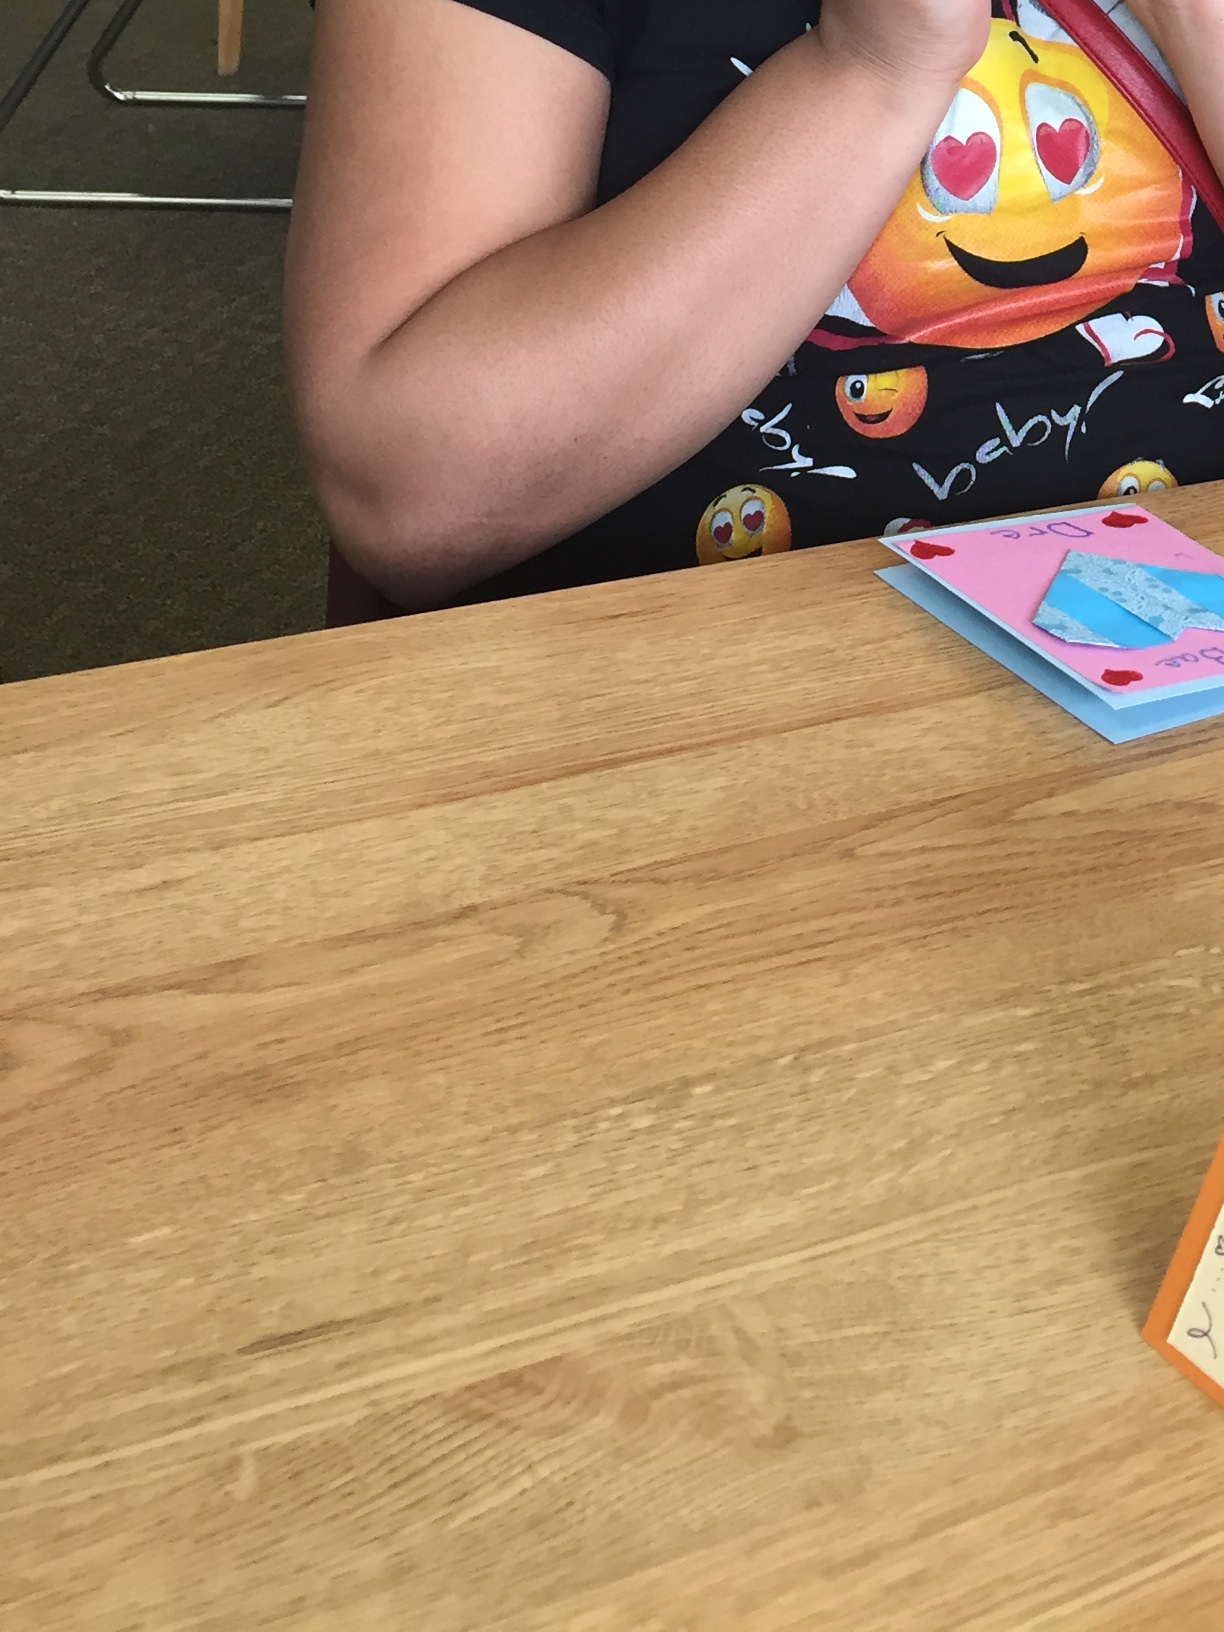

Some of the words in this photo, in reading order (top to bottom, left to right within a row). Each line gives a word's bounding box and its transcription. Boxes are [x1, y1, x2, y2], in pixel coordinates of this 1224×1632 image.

[741, 402, 858, 479] aby!
[912, 370, 1124, 501] baby!
[990, 521, 1095, 540] Dre
